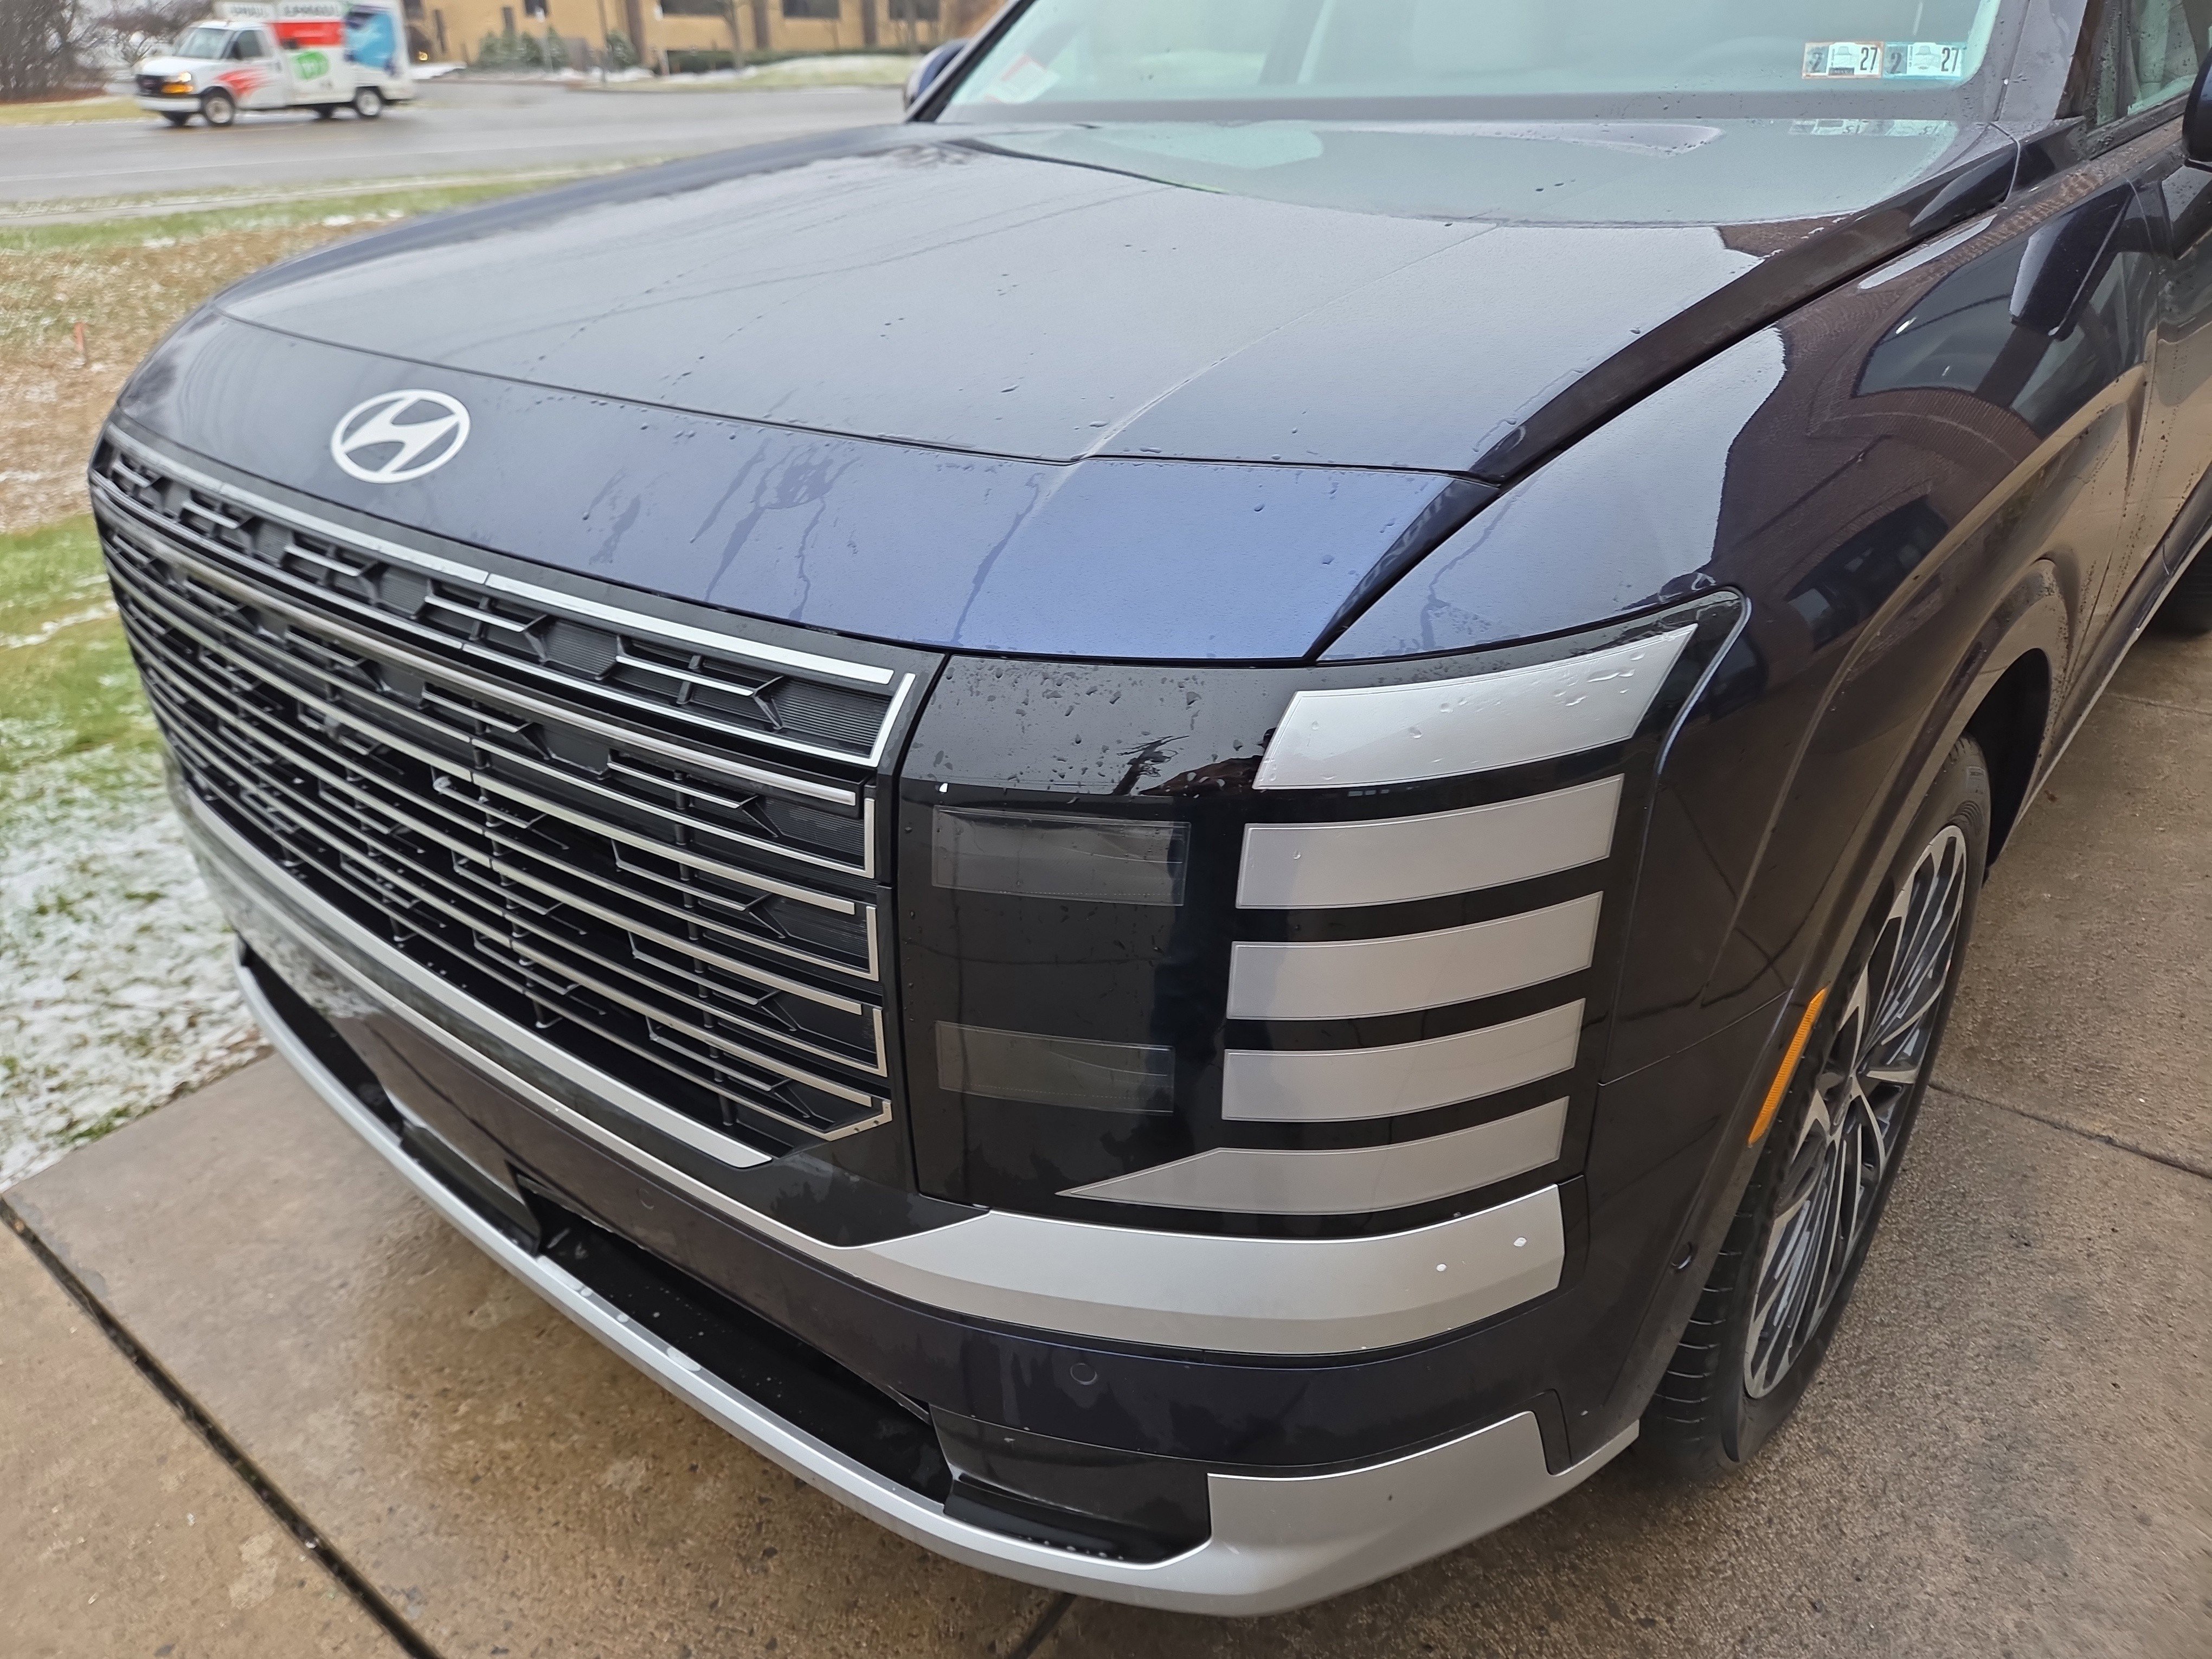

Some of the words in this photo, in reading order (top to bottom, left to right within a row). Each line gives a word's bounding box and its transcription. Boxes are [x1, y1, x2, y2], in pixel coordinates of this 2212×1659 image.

[1860, 47, 1878, 72] 27
[1887, 53, 1902, 74] 2
[1941, 47, 1959, 72] 27
